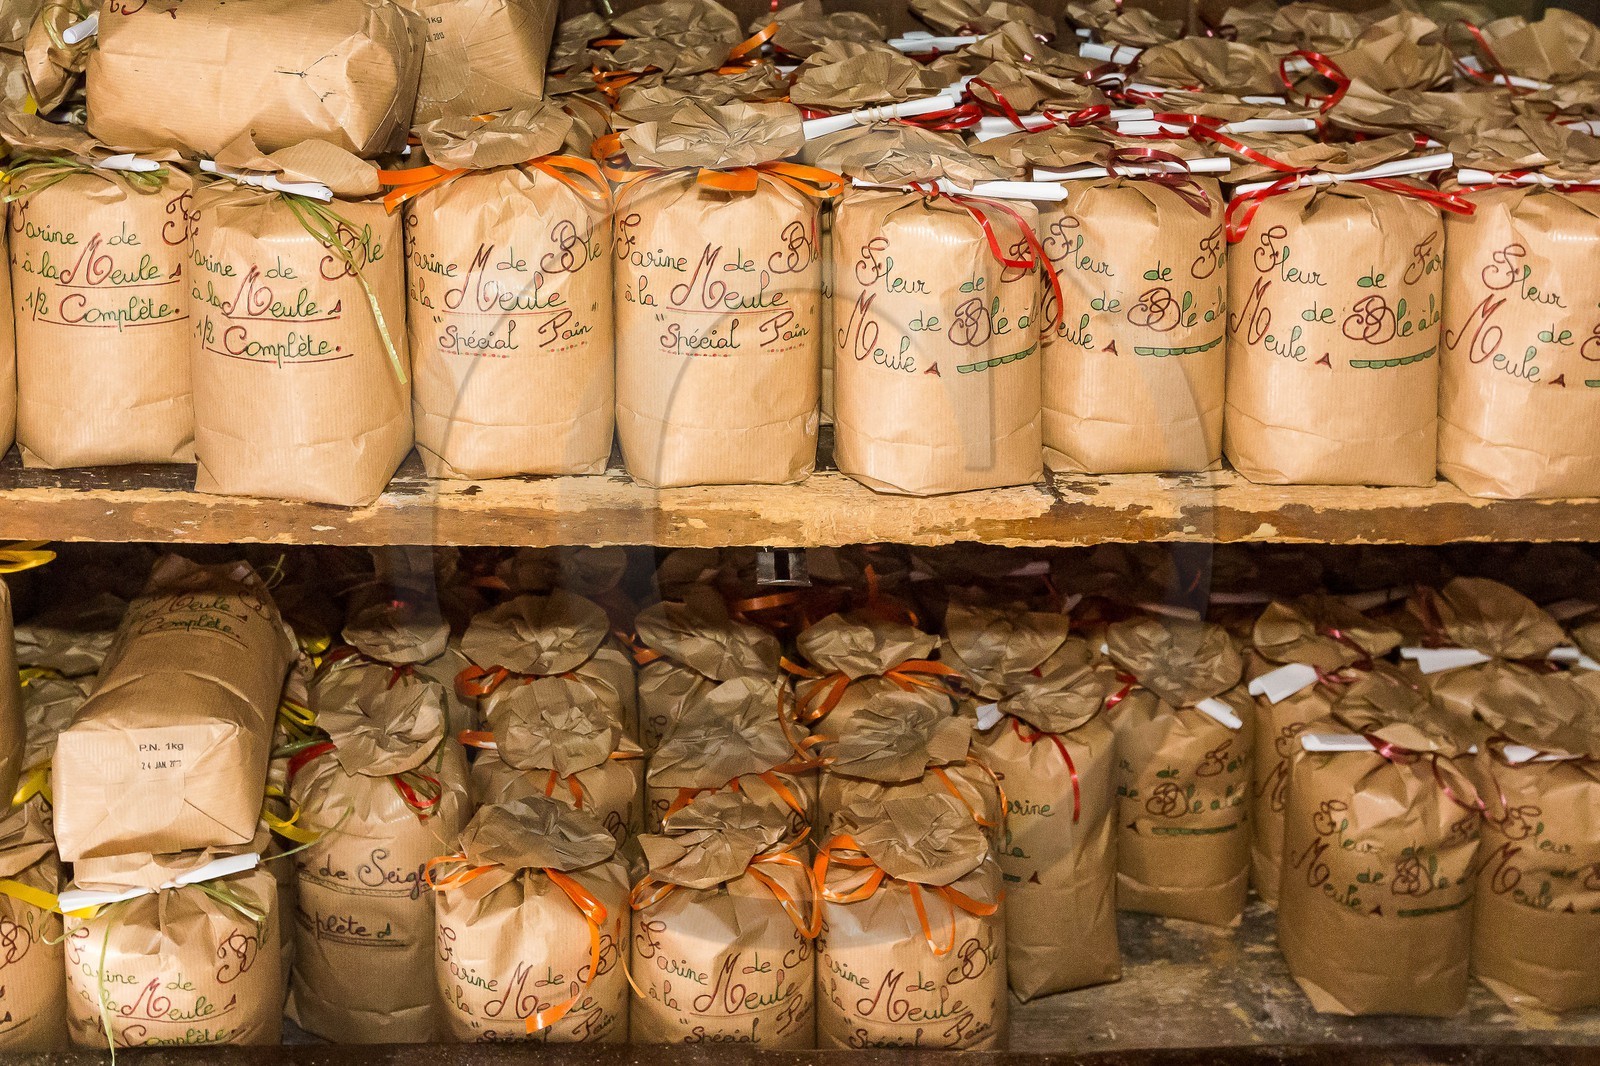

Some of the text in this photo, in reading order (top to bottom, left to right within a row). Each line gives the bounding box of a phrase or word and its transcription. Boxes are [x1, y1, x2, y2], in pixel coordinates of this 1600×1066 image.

[60, 232, 162, 286] Meule
[106, 221, 141, 246] de
[496, 246, 528, 272] de
[616, 213, 688, 273] Farine
[723, 248, 756, 272] de
[1042, 215, 1114, 277] Fleur
[1143, 260, 1173, 282] de
[1254, 225, 1327, 286] Fleur
[1357, 265, 1387, 288] de
[220, 263, 321, 318] Meule
[265, 256, 298, 279] de
[444, 243, 567, 312] Meule
[638, 275, 658, 307] la
[670, 242, 789, 310] Meule
[855, 236, 931, 295] Fleur
[958, 270, 985, 293] de
[1482, 243, 1567, 309] Fleur
[908, 309, 942, 332] de
[1091, 290, 1121, 314] de
[1230, 276, 1307, 362] Meule
[1301, 301, 1336, 324] de
[838, 289, 917, 373] Meule
[1445, 293, 1541, 383] Meule
[1537, 323, 1575, 346] de
[165, 742, 184, 751] 1kg
[319, 854, 348, 880] de
[438, 924, 498, 992] Farine
[535, 967, 565, 988] de
[636, 920, 771, 986] Farine de
[121, 977, 215, 1021] Meule
[166, 973, 196, 991] de
[484, 961, 598, 1019] Mele
[664, 980, 681, 1011] la
[694, 952, 798, 1014] Meule
[857, 969, 968, 1022] Meule
[906, 971, 935, 992] de
